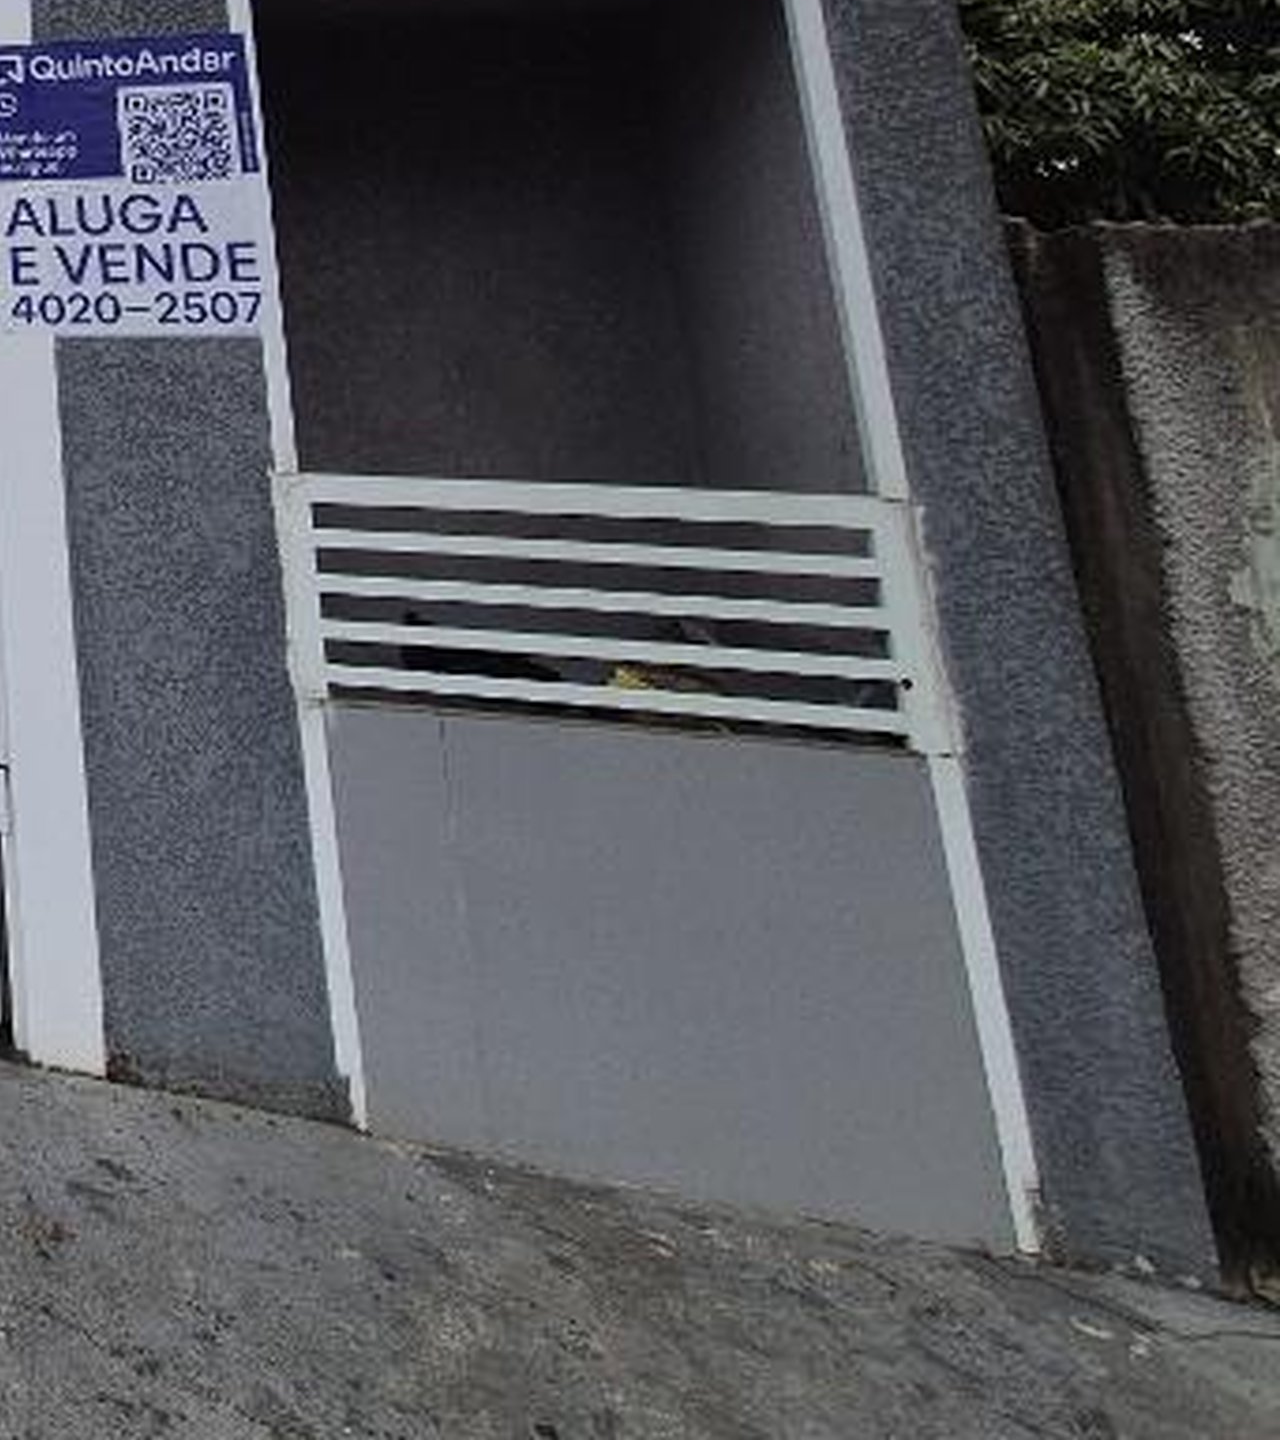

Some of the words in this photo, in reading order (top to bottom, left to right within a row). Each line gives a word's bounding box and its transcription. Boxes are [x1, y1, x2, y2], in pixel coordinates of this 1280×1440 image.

[5, 194, 208, 237] ALUGA
[10, 246, 40, 286] E
[54, 242, 261, 285] VENDE
[11, 291, 262, 326] 4020-2507
